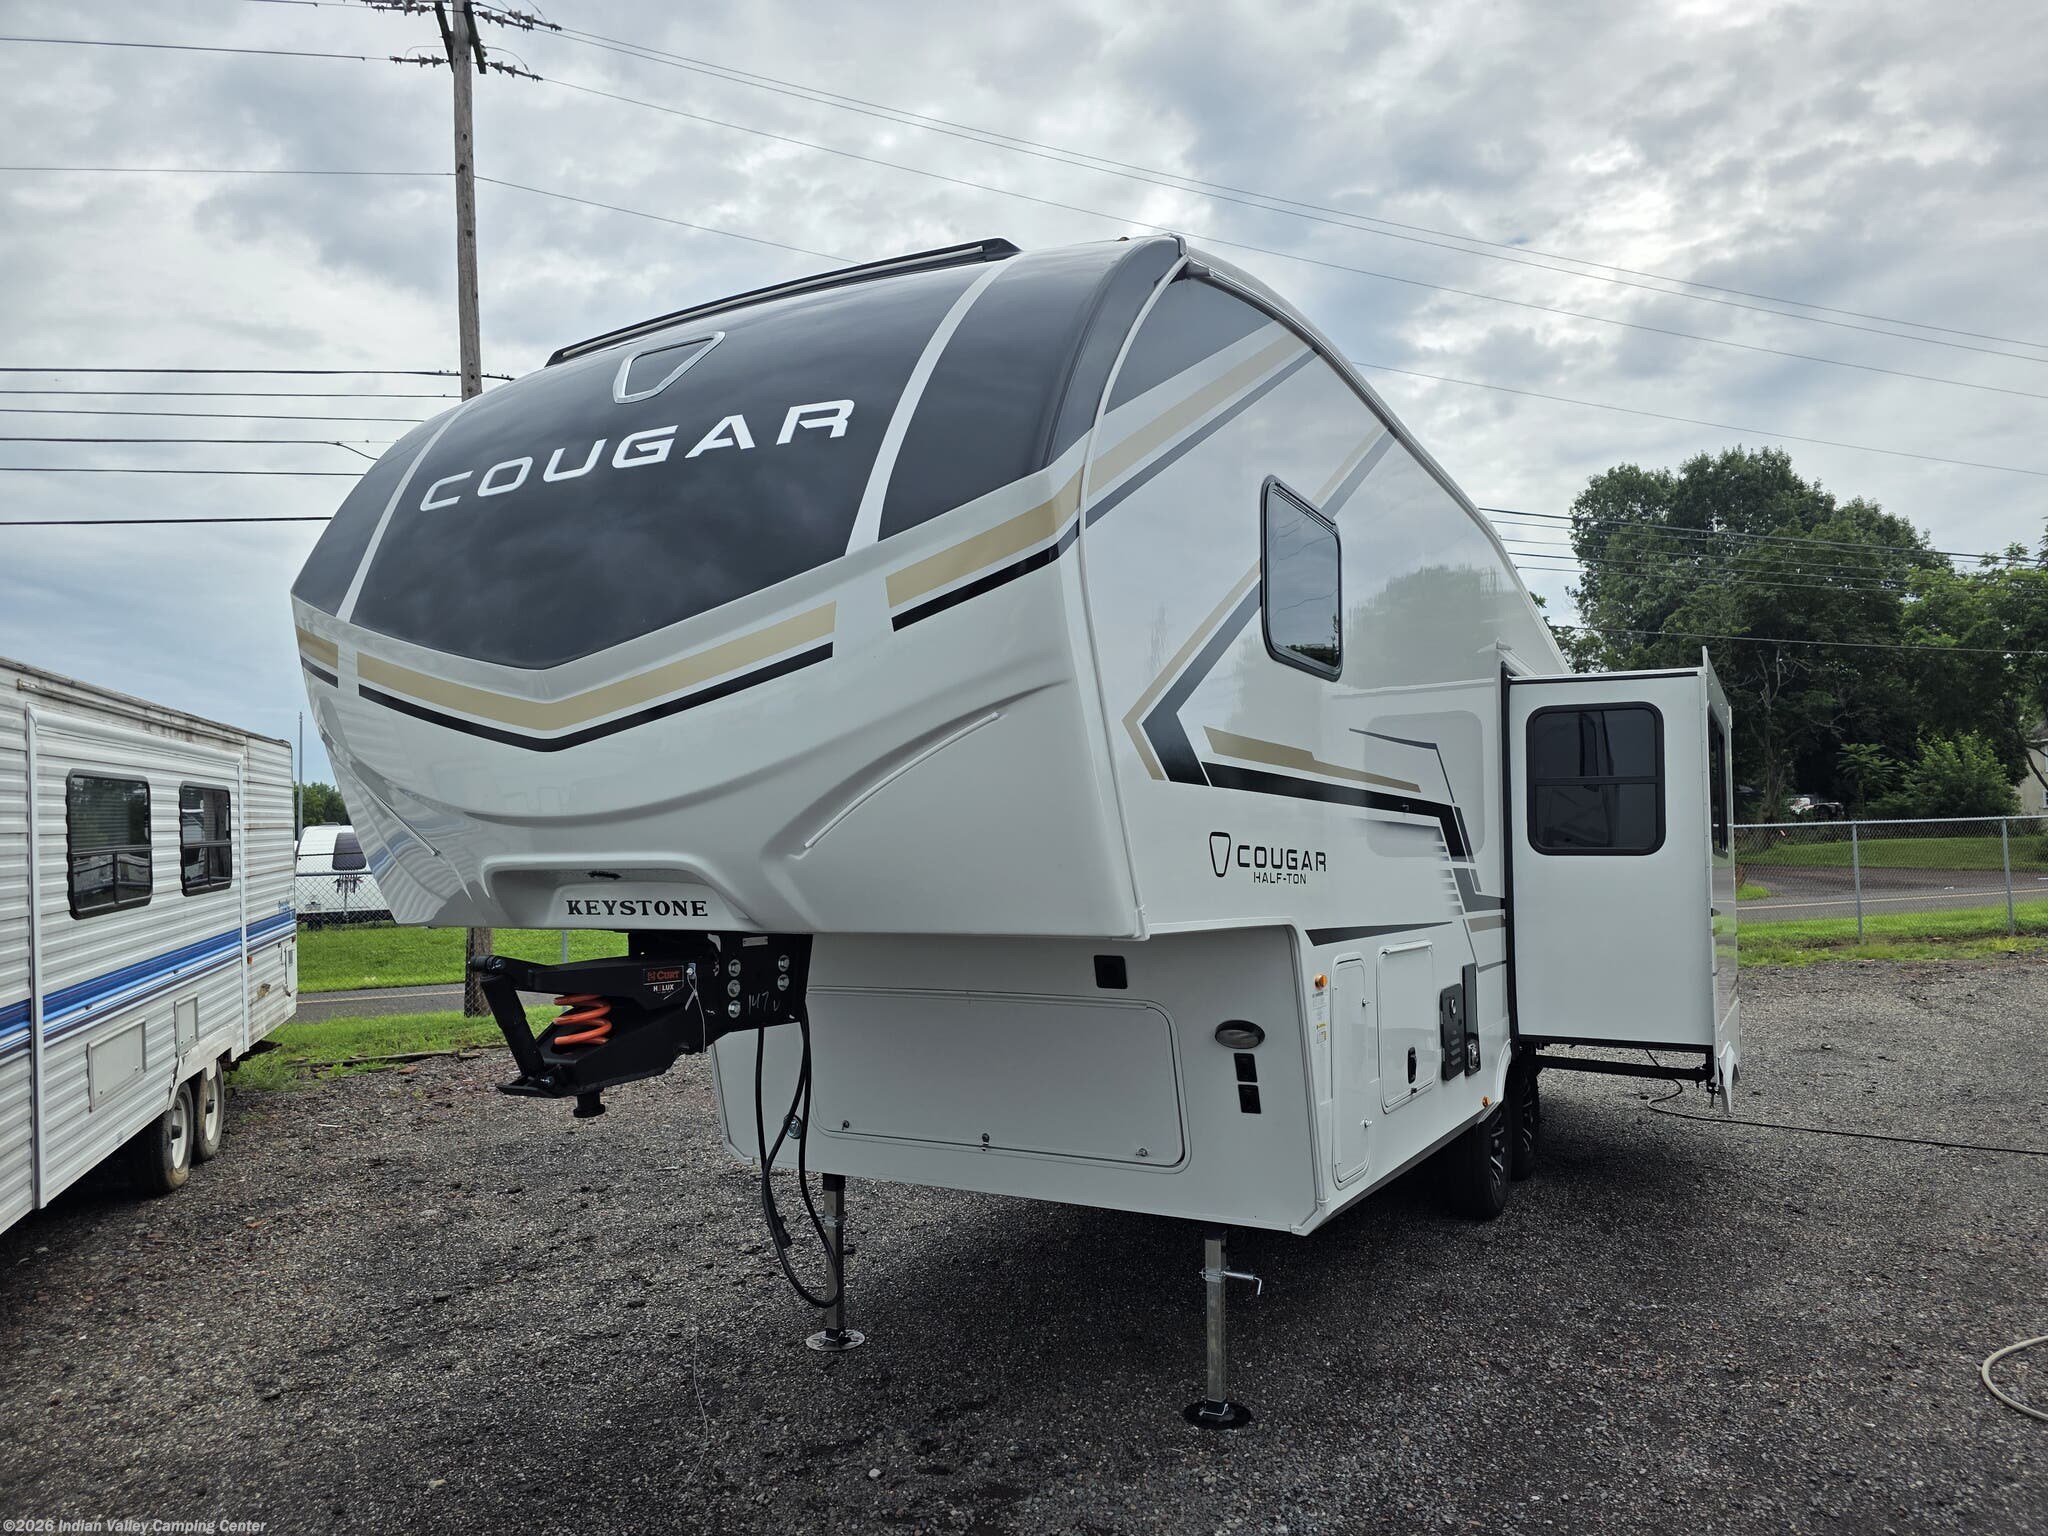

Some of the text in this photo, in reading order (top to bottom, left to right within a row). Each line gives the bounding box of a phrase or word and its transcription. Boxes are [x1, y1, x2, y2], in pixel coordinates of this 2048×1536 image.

[420, 399, 855, 512] COUGAR
[1237, 844, 1327, 872] COUGAR
[1253, 871, 1307, 884] HALF-TON
[566, 899, 709, 917] KEYSTONE
